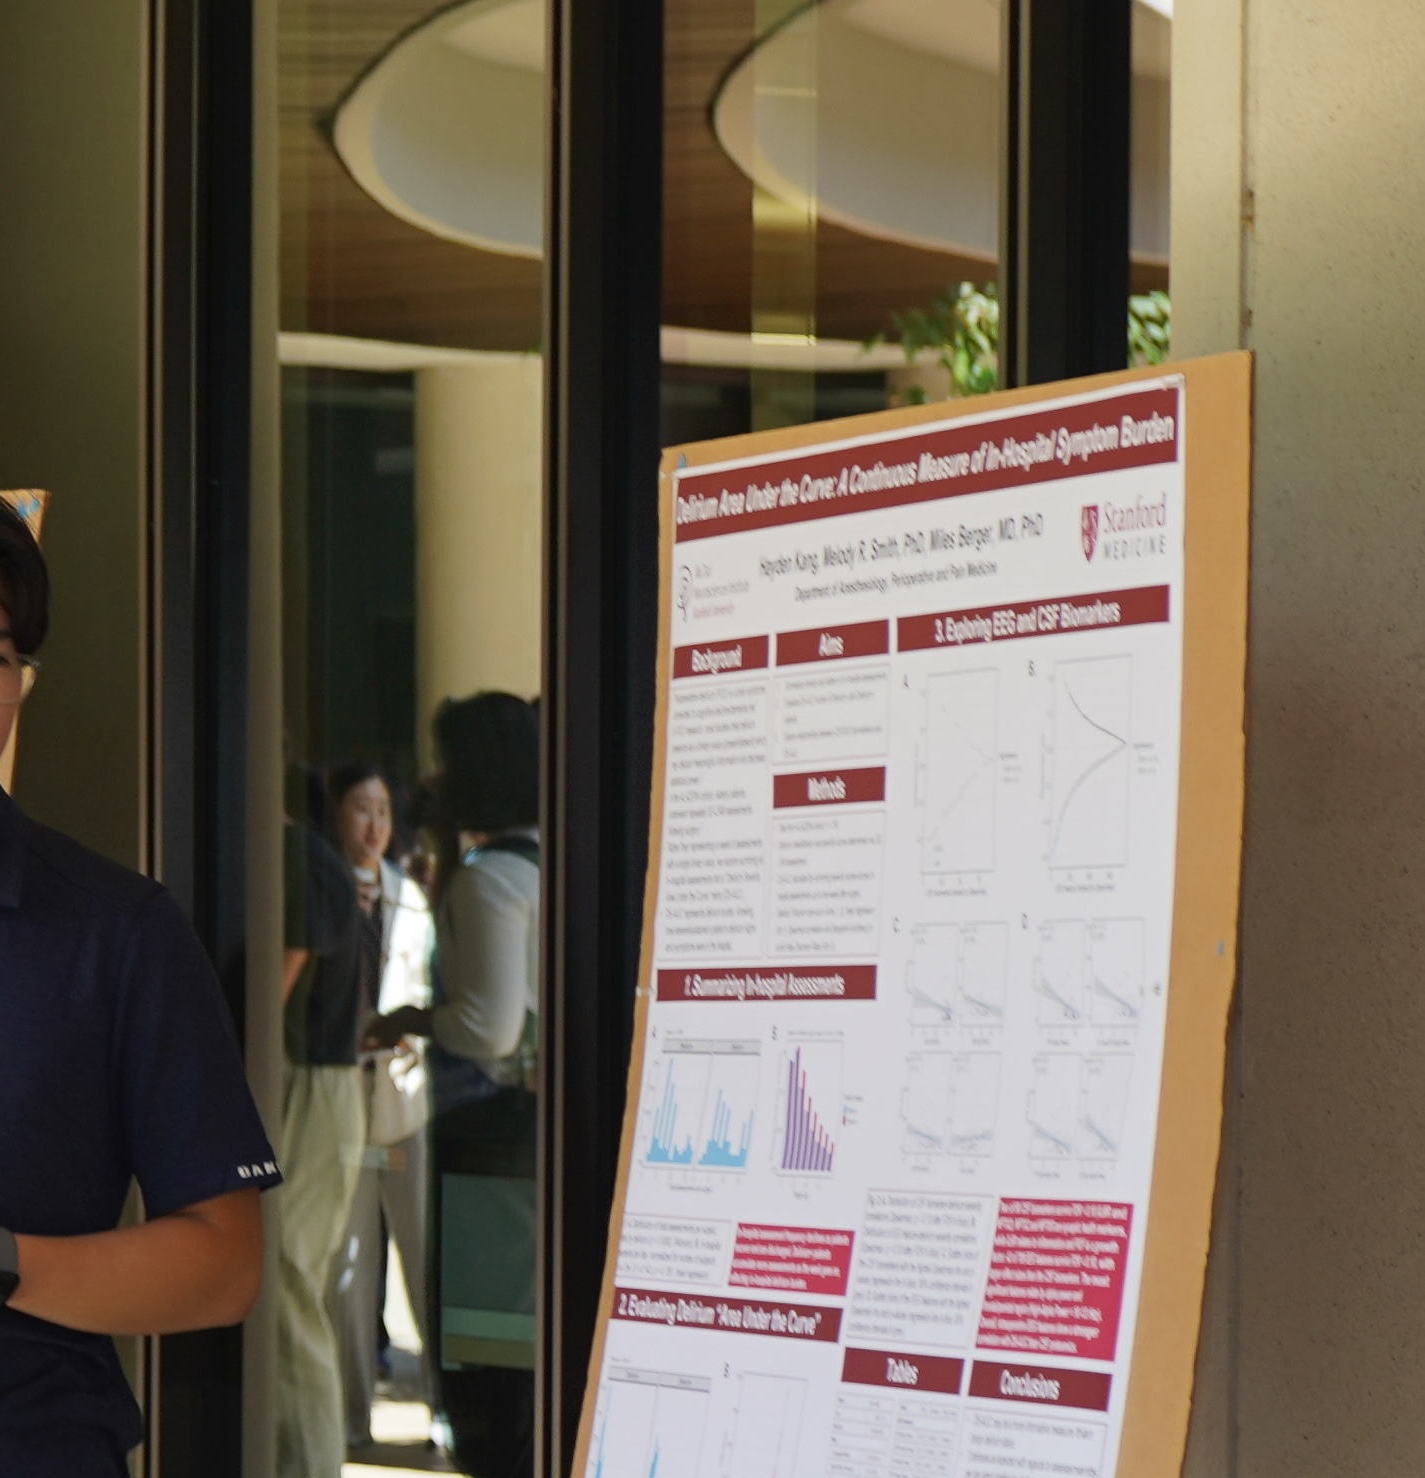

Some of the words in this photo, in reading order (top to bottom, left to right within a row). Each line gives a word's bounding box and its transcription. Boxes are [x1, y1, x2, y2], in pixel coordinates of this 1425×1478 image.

[718, 488, 744, 518] Area
[745, 481, 780, 512] Under
[779, 478, 798, 507] the
[836, 467, 848, 496] A
[849, 461, 917, 495] Continuous
[917, 449, 970, 483] Measure
[970, 441, 986, 475] of
[986, 430, 1056, 472] In-Hospital
[1056, 422, 1119, 466] Symptom
[1119, 410, 1175, 448] Burden
[1103, 492, 1167, 534] Stanford
[930, 527, 955, 551] Miles
[1021, 513, 1044, 538] PhD
[1103, 535, 1166, 560] MEDICINE
[946, 613, 992, 645] Exploring
[1017, 607, 1038, 634] and
[1061, 599, 1121, 628] Biomarkers
[692, 644, 742, 675] Background
[628, 1293, 676, 1326] Evaluating
[1000, 1368, 1060, 1401] Conclusions
